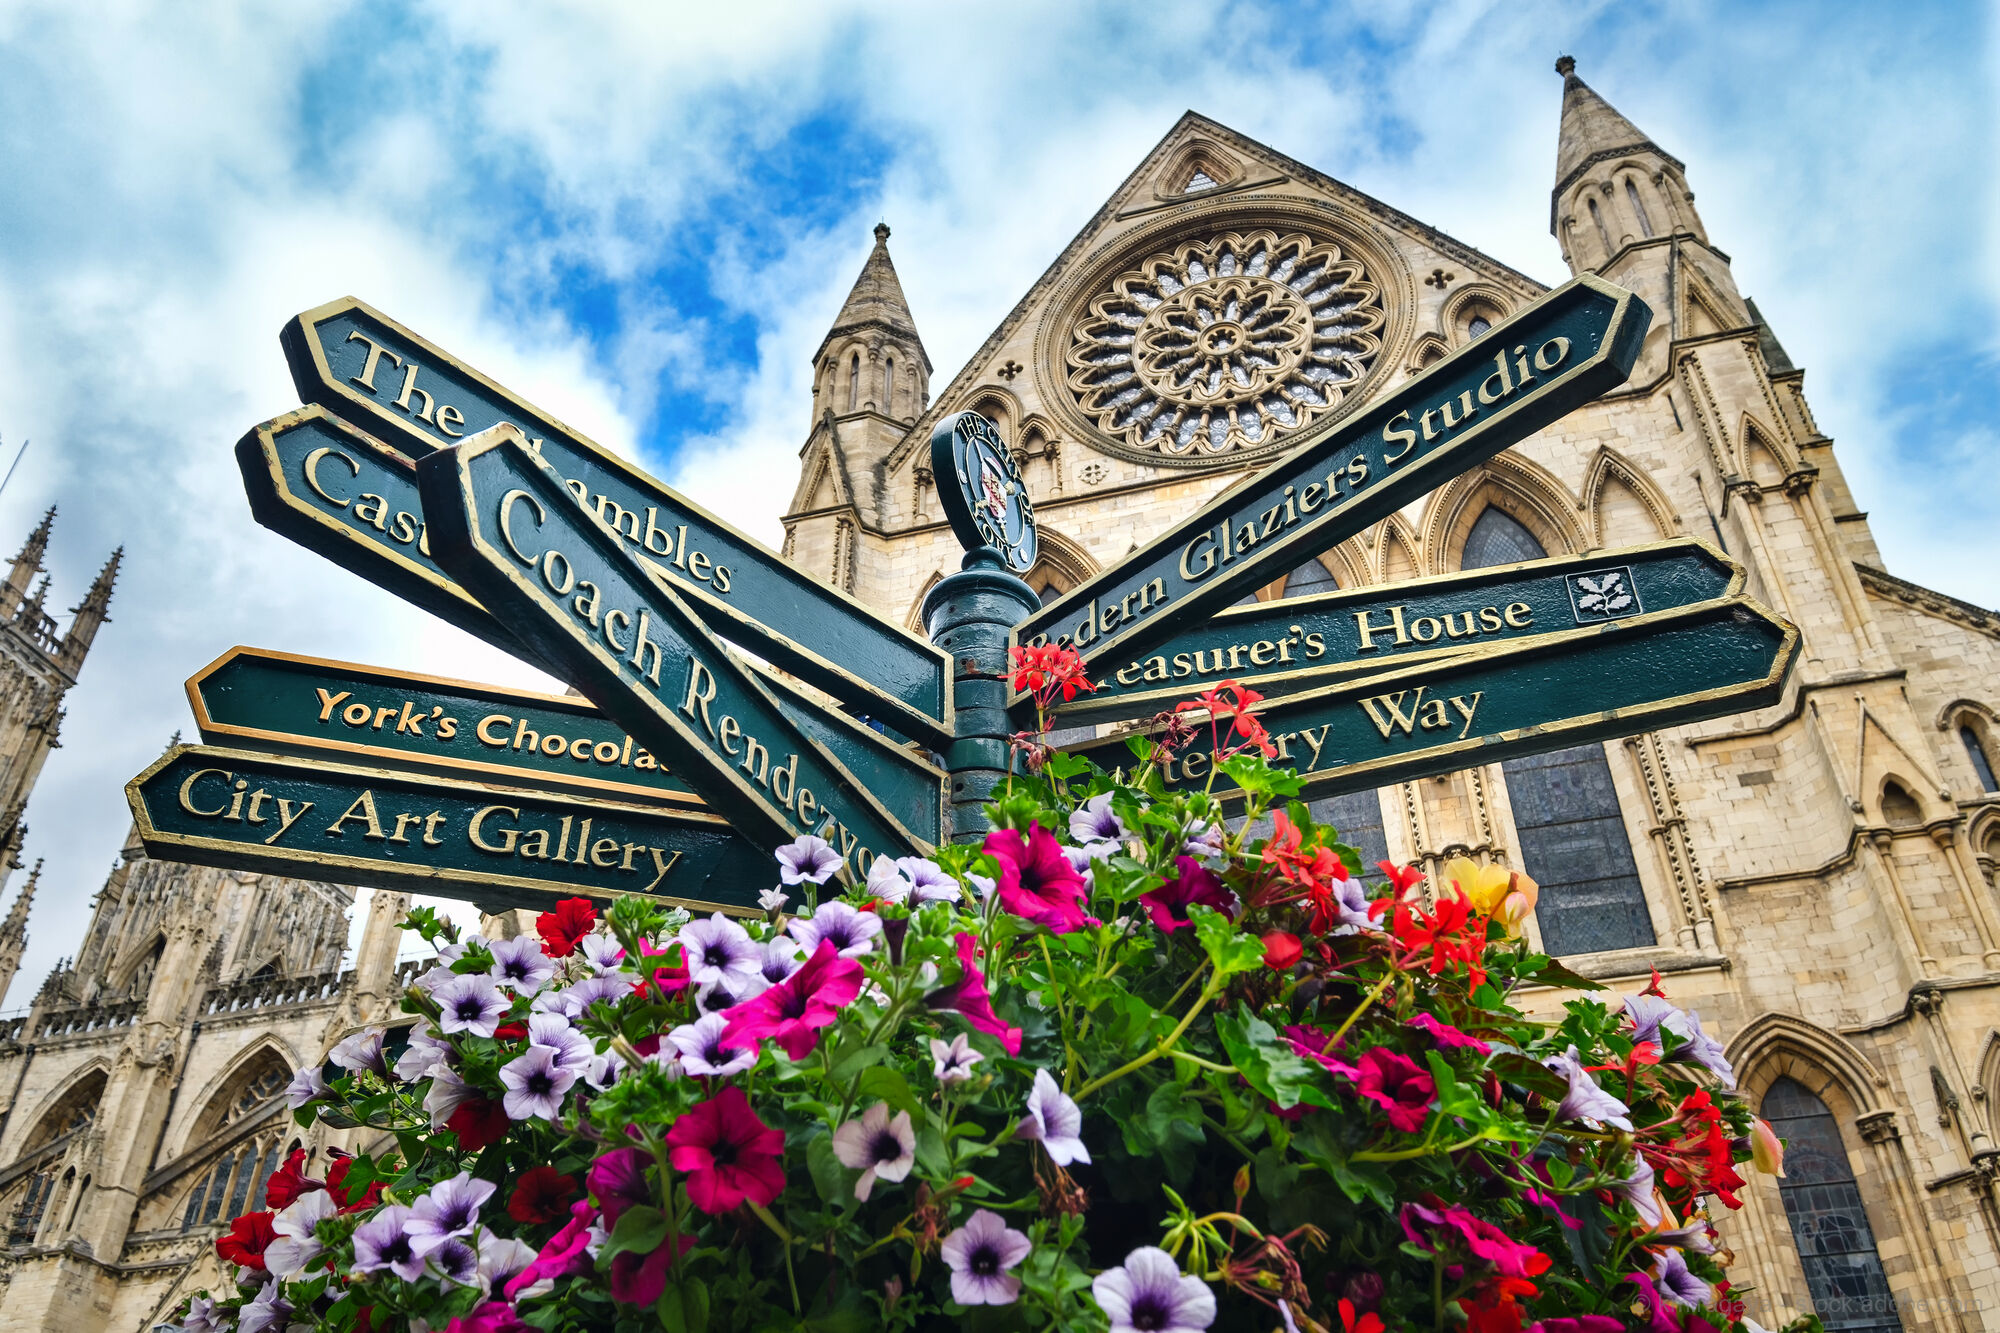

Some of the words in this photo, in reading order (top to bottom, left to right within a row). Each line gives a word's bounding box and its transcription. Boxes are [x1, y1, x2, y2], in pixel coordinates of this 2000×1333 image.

[346, 331, 466, 438] The
[533, 439, 732, 593] ambles
[957, 416, 984, 441] THE
[1179, 453, 1369, 583] Glaziers
[1382, 336, 1572, 468] Studio
[500, 488, 661, 682] Coach
[1095, 627, 1327, 689] easurer's
[1352, 601, 1533, 653] House
[315, 687, 458, 741] York's
[476, 714, 669, 772] Chocola
[1358, 685, 1485, 741] Way
[178, 768, 315, 845] City
[325, 790, 447, 846] Art
[468, 805, 683, 893] Gallery
